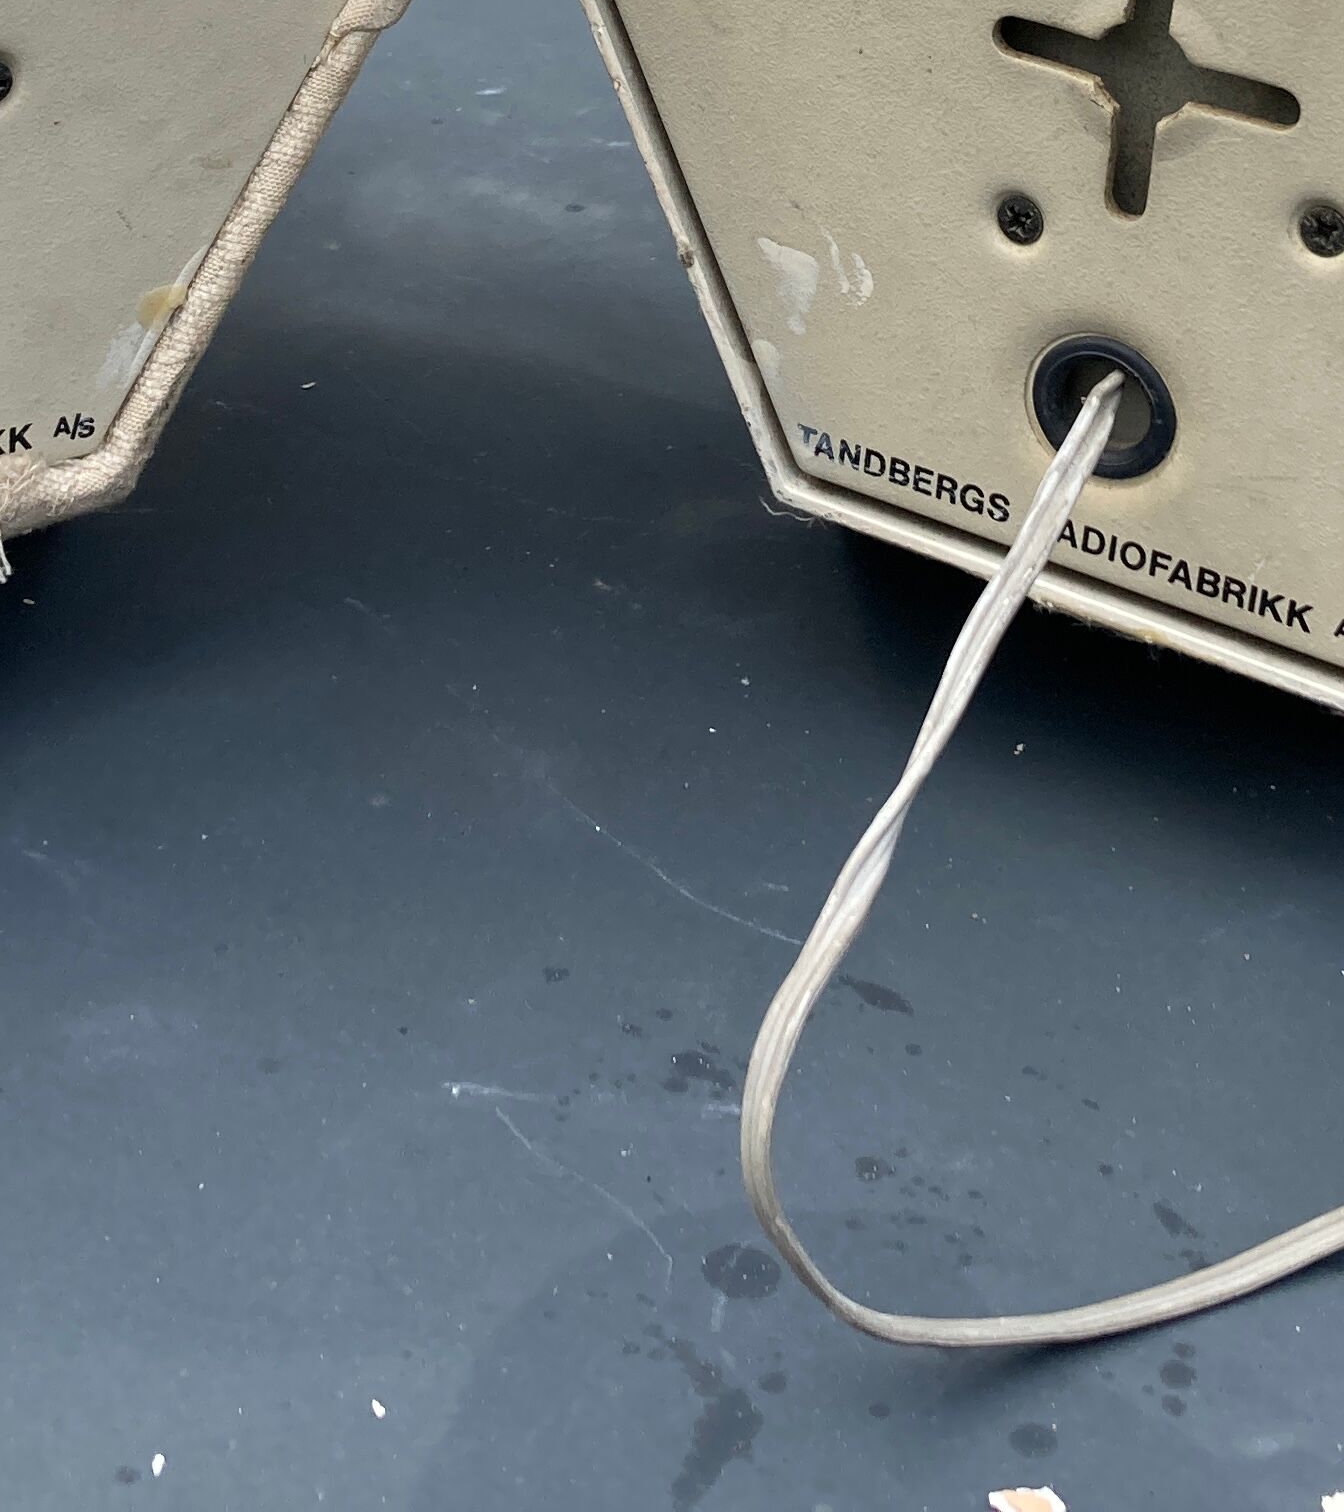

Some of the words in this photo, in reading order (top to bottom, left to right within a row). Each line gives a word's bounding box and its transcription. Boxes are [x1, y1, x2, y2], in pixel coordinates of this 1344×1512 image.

[53, 413, 96, 440] A/S
[798, 423, 1012, 523] TANDBERGS
[1036, 518, 1314, 634] ADIOFABRIKK
